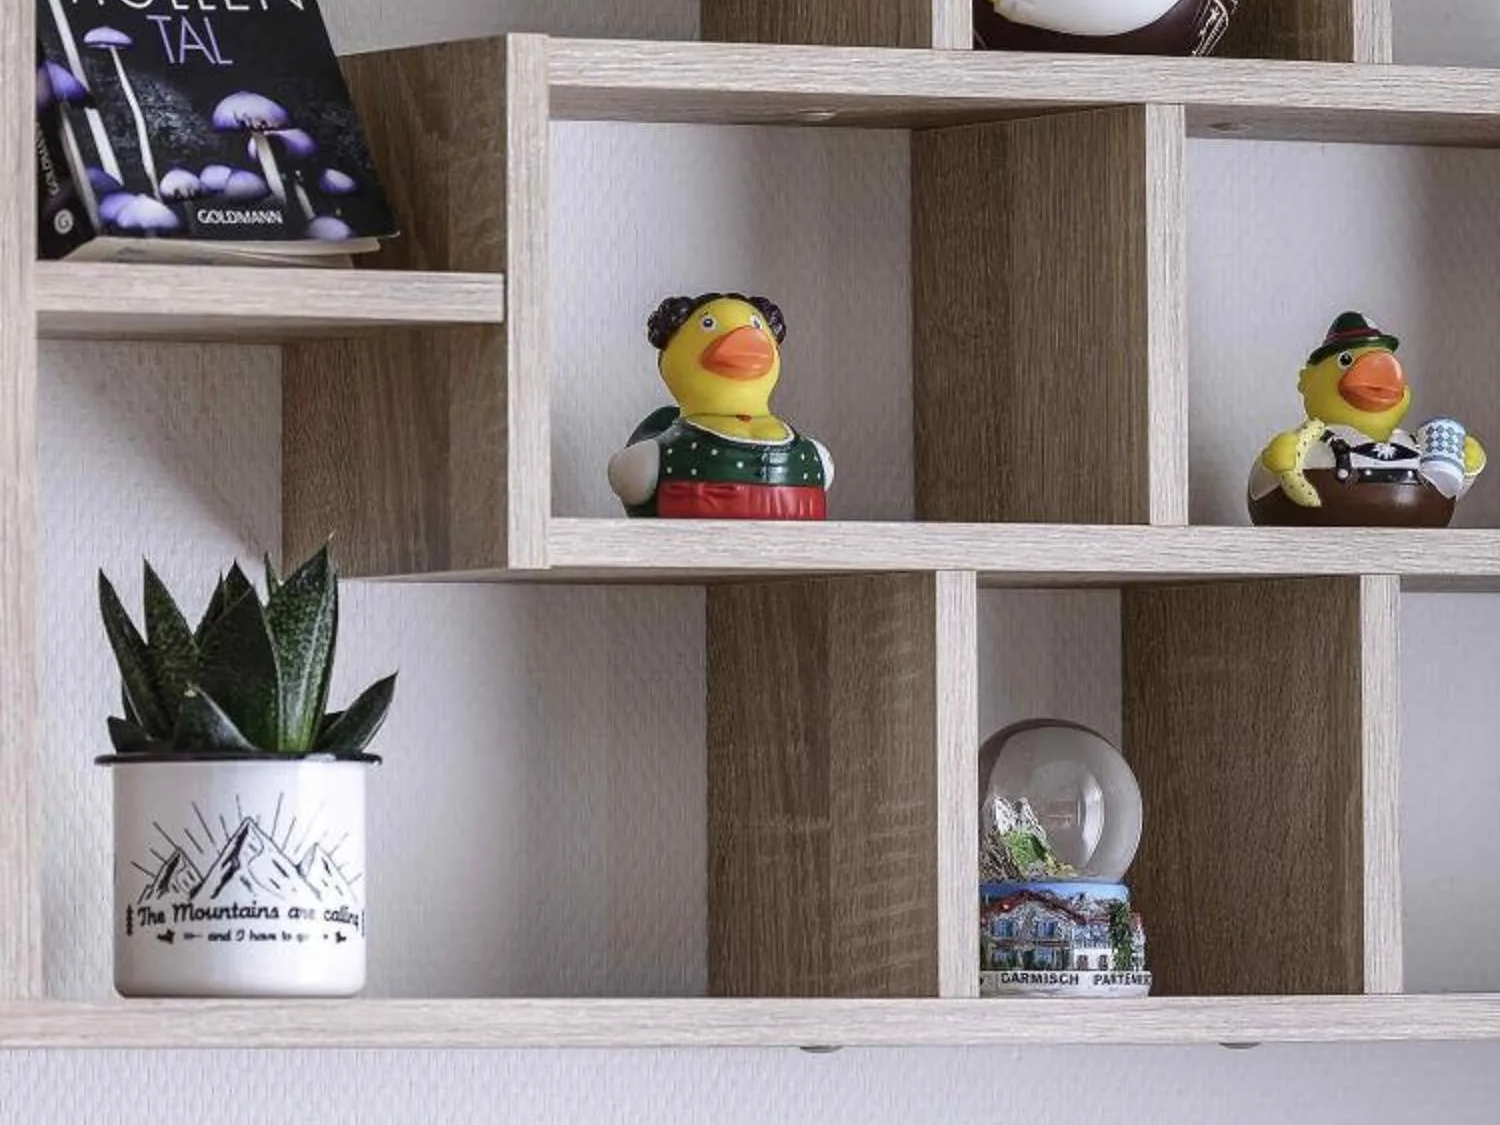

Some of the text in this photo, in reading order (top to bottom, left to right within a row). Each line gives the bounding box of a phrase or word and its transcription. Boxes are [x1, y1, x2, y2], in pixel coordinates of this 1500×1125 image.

[145, 13, 234, 66] TAL
[197, 208, 284, 225] GOLDMANN
[136, 906, 167, 928] The
[172, 900, 280, 923] Mountains
[287, 905, 316, 920] are
[207, 929, 232, 942] and
[1000, 972, 1080, 986] GARMISCH
